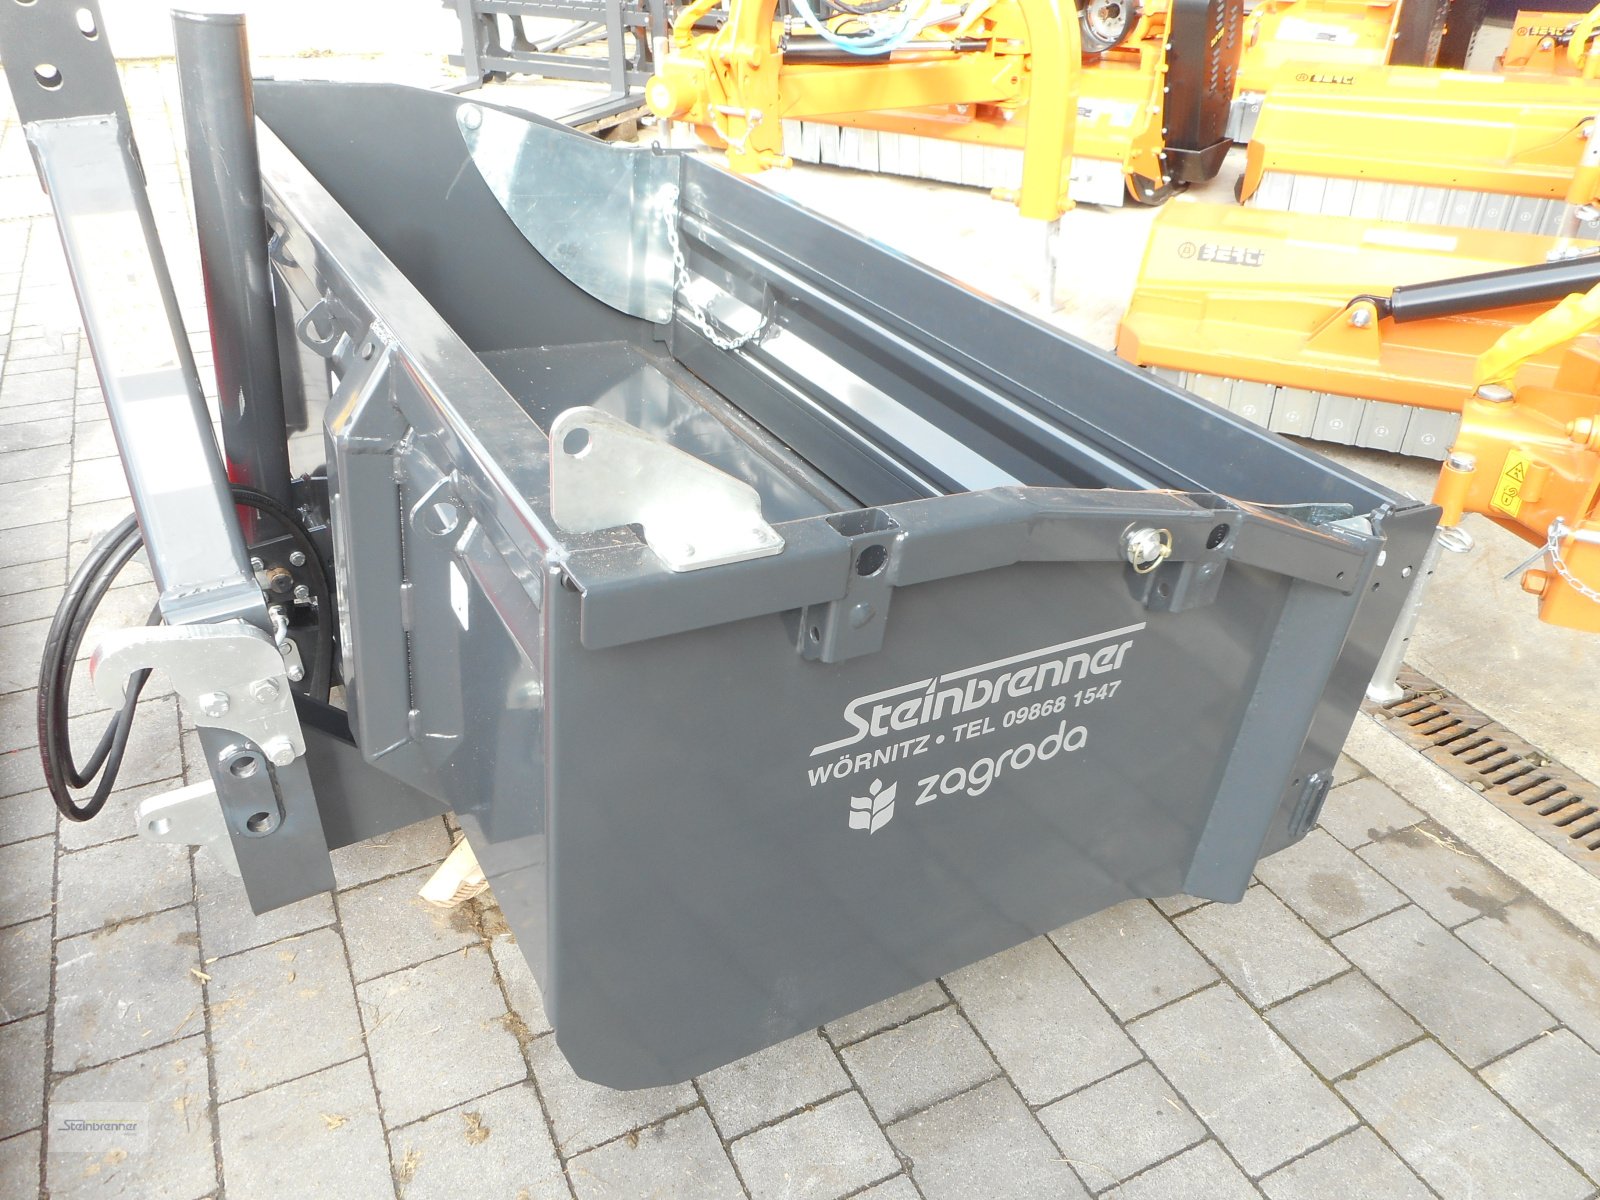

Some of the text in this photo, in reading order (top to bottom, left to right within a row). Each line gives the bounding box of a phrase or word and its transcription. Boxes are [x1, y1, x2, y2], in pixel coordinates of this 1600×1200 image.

[807, 680, 1122, 787] WÖRNITZ TEL 09868 1547
[809, 639, 1134, 757] Steinbrenner
[914, 719, 1088, 806] zagroda
